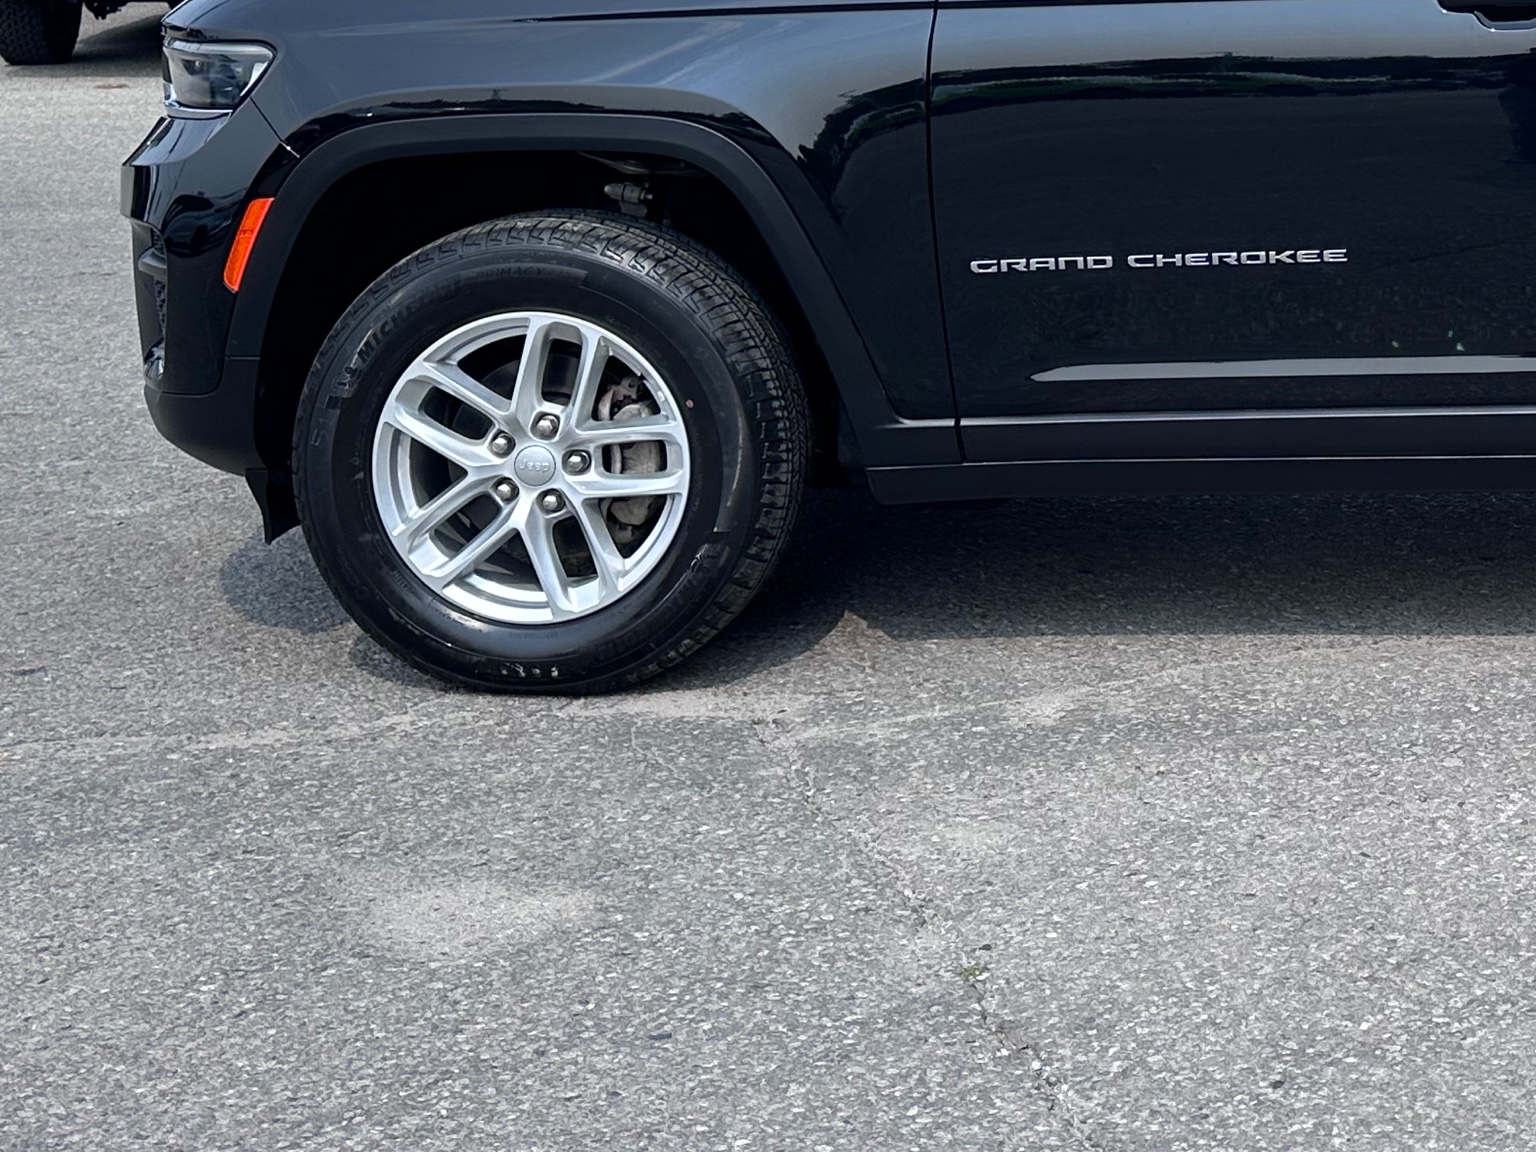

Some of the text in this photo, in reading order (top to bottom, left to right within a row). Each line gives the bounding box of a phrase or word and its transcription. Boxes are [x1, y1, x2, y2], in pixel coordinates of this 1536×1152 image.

[970, 249, 1348, 273] GRAND CHEROKEE
[518, 458, 550, 474] Jeep
